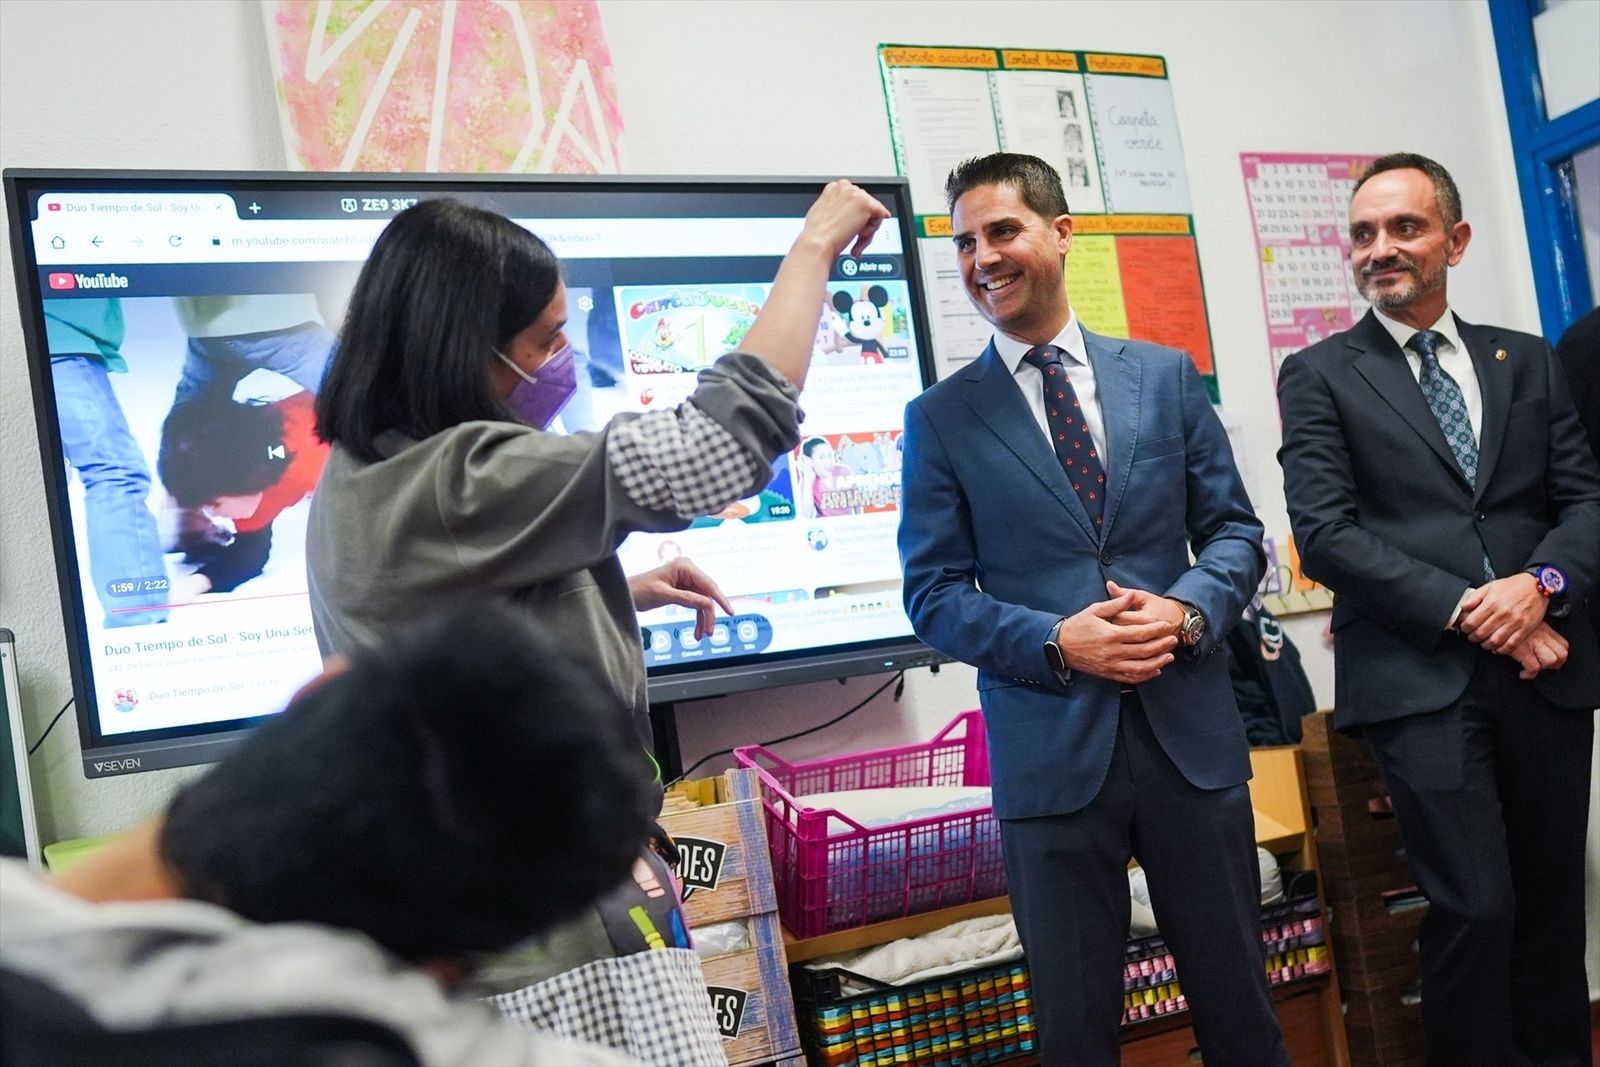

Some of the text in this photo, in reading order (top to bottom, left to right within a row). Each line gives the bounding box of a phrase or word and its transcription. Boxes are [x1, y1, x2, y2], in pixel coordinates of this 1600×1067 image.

[90, 202, 129, 215] Tiempo
[131, 202, 143, 212] de
[146, 202, 162, 212] Sol
[74, 272, 129, 289] YouTube
[110, 582, 135, 593] 1:59
[144, 579, 169, 591] 2:22
[134, 638, 184, 653] Tiempo
[187, 635, 203, 648] de
[207, 632, 227, 645] Sol
[239, 630, 262, 644] Soy
[265, 627, 290, 640] Una
